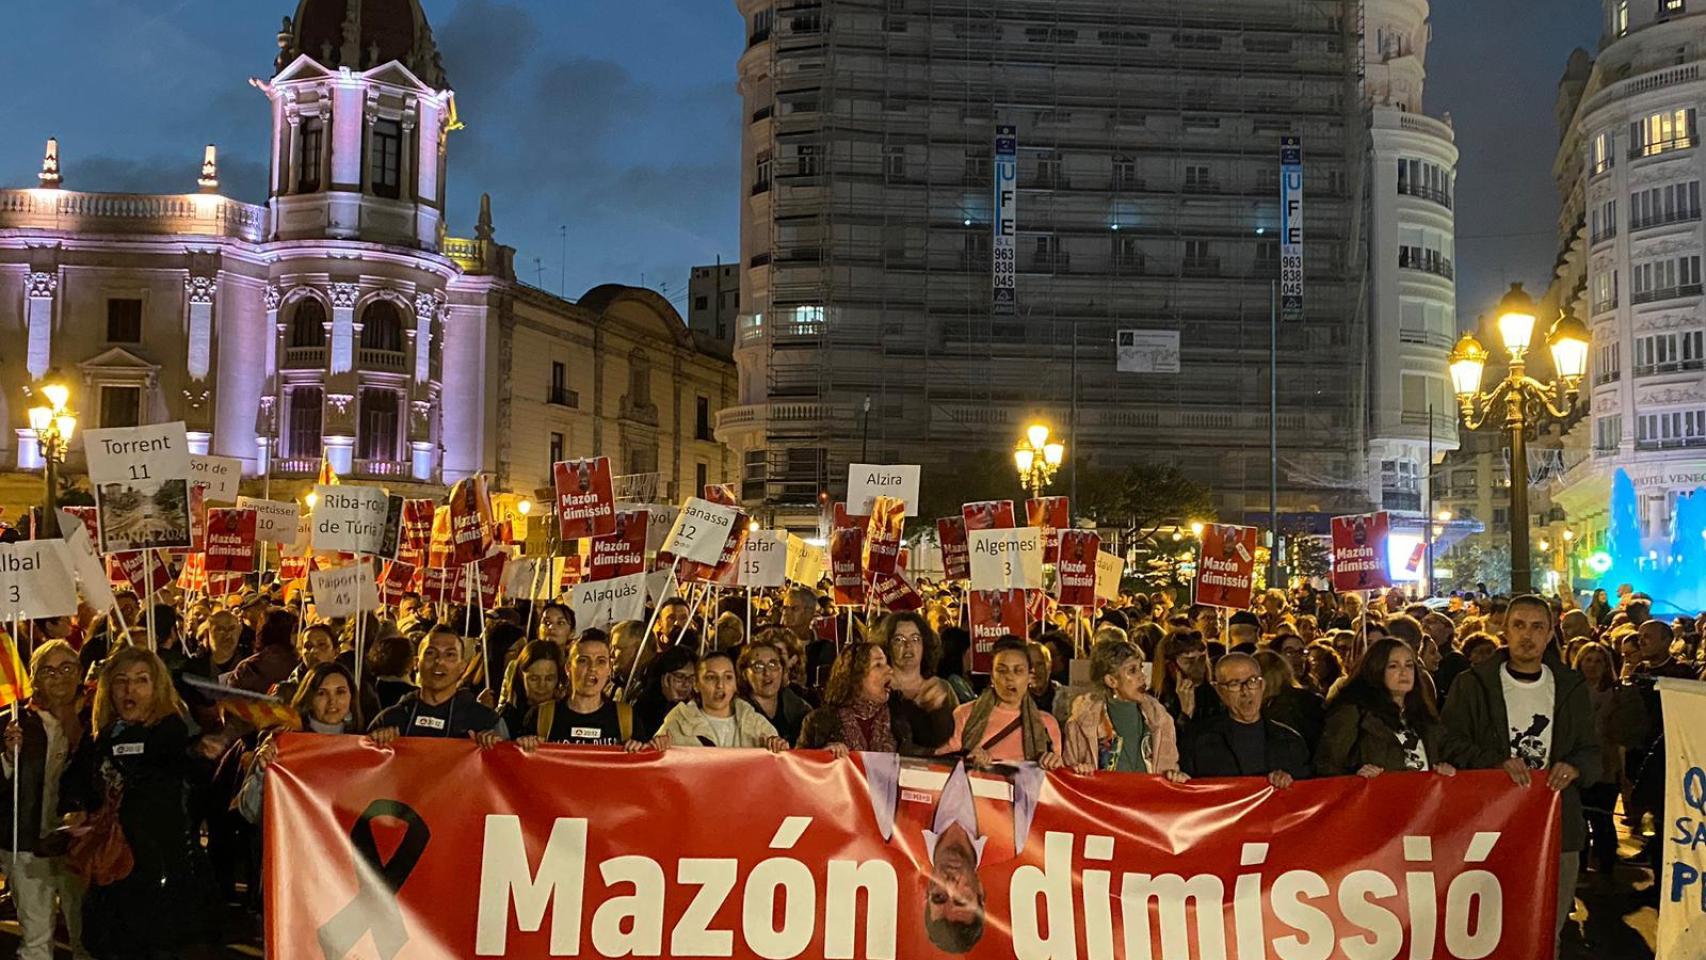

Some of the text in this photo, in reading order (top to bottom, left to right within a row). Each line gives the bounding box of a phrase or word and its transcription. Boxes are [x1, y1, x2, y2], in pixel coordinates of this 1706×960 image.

[994, 248, 1014, 260] 963
[994, 261, 1014, 274] 838
[1282, 256, 1302, 269] 963
[994, 275, 1014, 287] 045
[1282, 269, 1302, 282] 838
[1282, 283, 1302, 295] 045
[101, 435, 171, 455] Torrent
[128, 464, 151, 481] 11
[211, 463, 228, 475] de
[866, 473, 902, 486] Alzira
[561, 491, 598, 507] Mazón
[563, 502, 611, 520] dimissió
[259, 519, 274, 530] 10
[319, 519, 340, 534] de
[676, 522, 697, 541] 12
[158, 527, 188, 541] 2024
[209, 533, 242, 544] Mazón
[208, 545, 251, 557] dimissió
[594, 539, 630, 553] Mazón
[744, 537, 776, 552] fafar
[974, 536, 1037, 555] Algemesí
[593, 552, 641, 566] dimissió
[1336, 546, 1373, 560] Mazón
[0, 551, 41, 573] lbal
[743, 561, 760, 574] 15
[1004, 561, 1012, 576] 3
[1060, 560, 1086, 573] Mazón
[1203, 556, 1239, 572] Mazón
[319, 573, 366, 589] Paiporta
[1202, 571, 1249, 589] dimissió
[9, 584, 20, 603] 3
[582, 583, 638, 605] Alaquàs
[607, 607, 614, 621] 1
[974, 623, 1011, 637] Mazón
[474, 813, 899, 960] Mazón
[1670, 861, 1706, 913] P
[1009, 830, 1502, 960] dimissió
